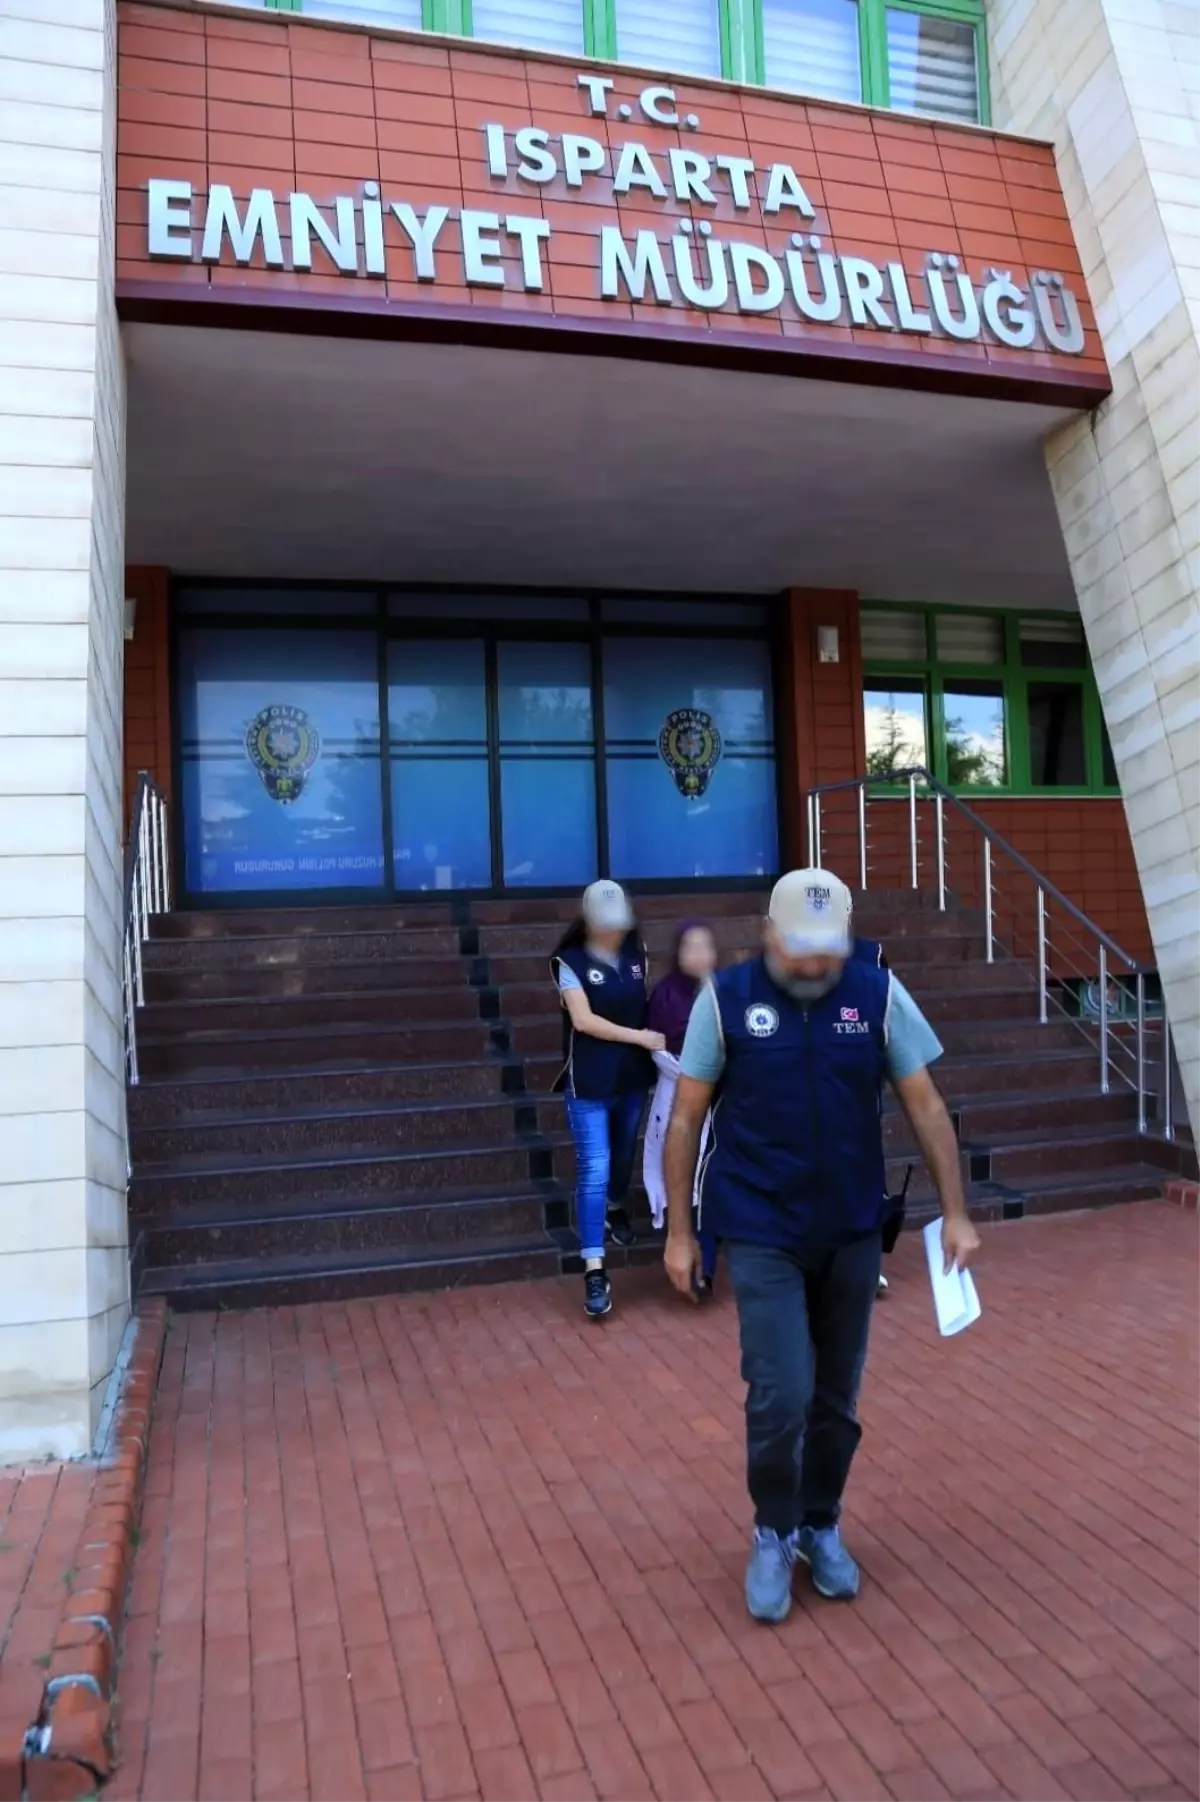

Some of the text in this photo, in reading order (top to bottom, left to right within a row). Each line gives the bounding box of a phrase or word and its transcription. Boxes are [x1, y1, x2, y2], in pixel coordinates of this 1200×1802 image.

[577, 75, 700, 130] T.C.
[485, 123, 817, 219] ISPARTA
[147, 178, 1085, 354] EMNİYET MÜDÜRLÜĞÜ
[805, 887, 830, 899] TEM
[833, 1022, 869, 1034] TEM
